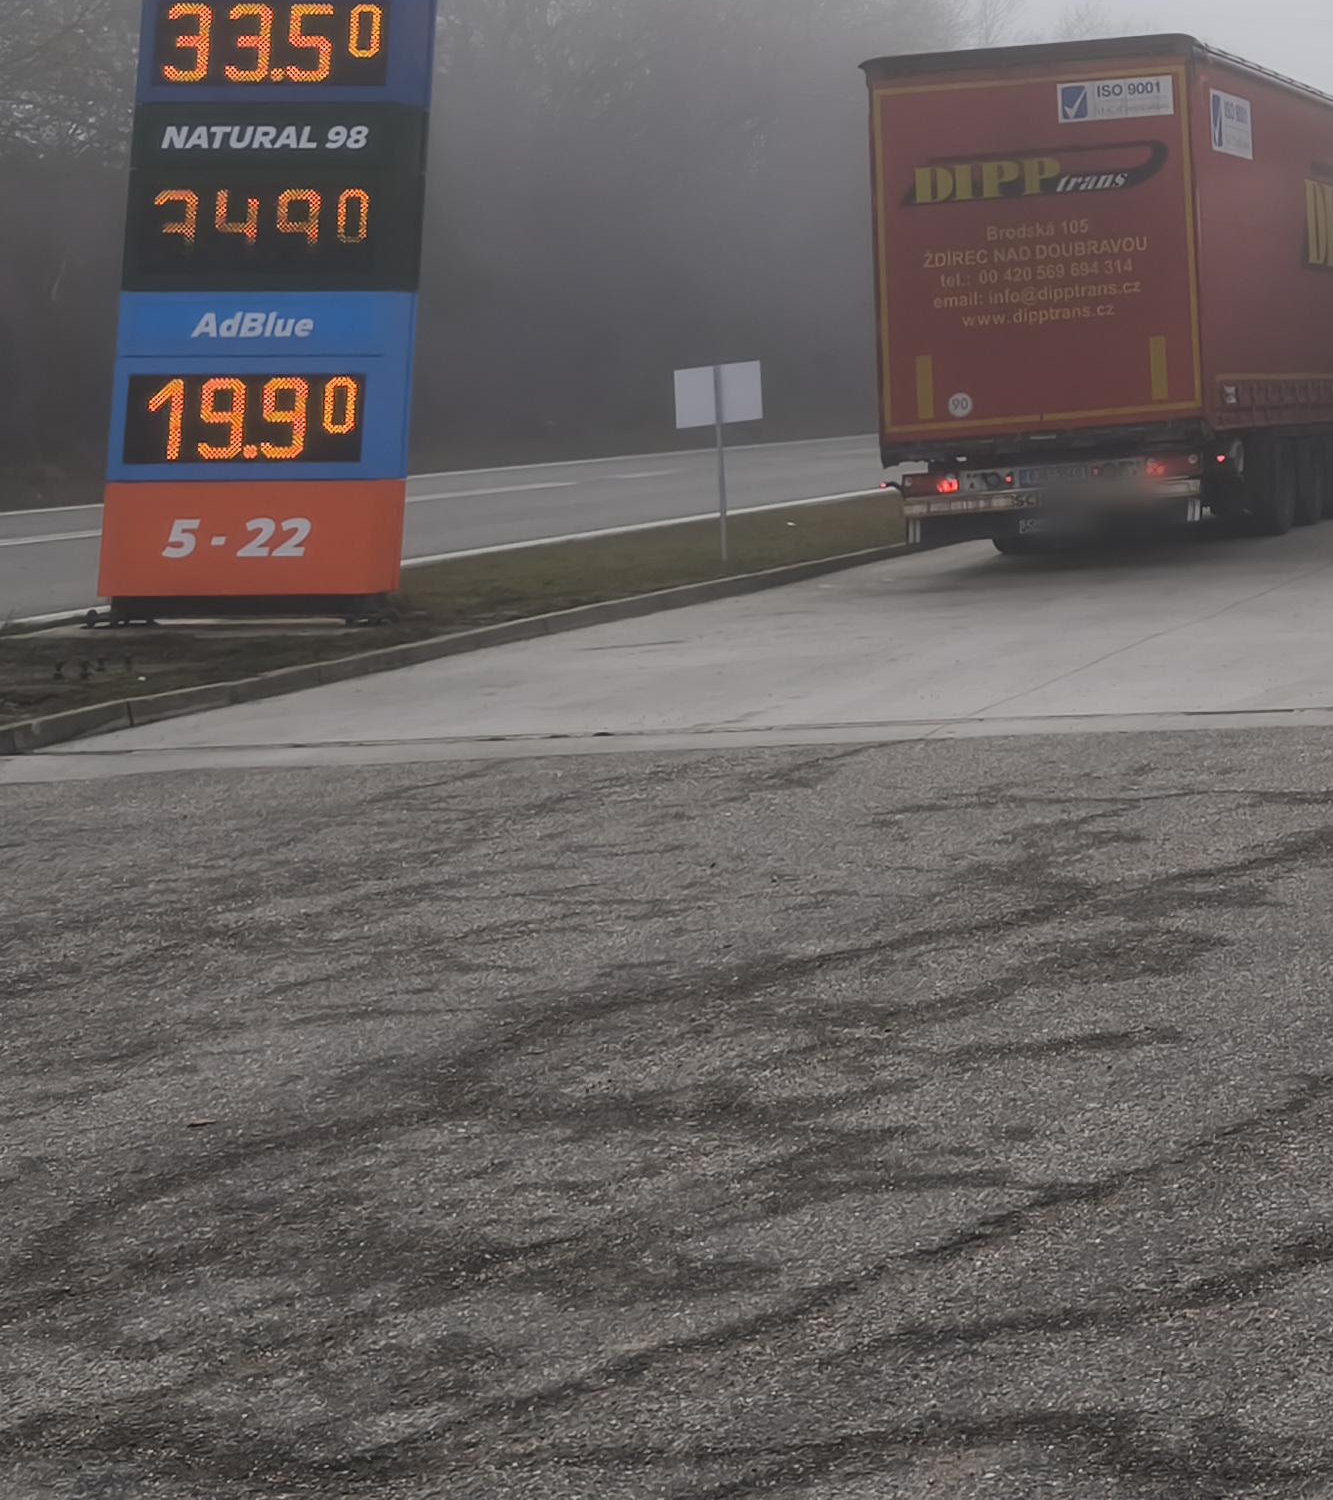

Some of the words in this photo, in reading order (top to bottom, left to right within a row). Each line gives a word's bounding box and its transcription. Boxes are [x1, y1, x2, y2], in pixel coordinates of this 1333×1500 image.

[1096, 84, 1122, 98] ISO
[1127, 81, 1161, 97] 9001
[161, 126, 317, 149] NATURAL
[325, 125, 369, 149] 98
[914, 156, 1062, 204] DIPP
[1055, 171, 1128, 194] trans
[986, 221, 1055, 242] Brodská
[1061, 218, 1089, 235] 105
[993, 245, 1031, 263] NAD
[1035, 235, 1148, 260] DOUBRAVOU
[978, 269, 998, 284] 00
[1003, 265, 1032, 282] 420
[1104, 258, 1133, 274] 314
[191, 312, 314, 338] AdBlue
[952, 396, 969, 410] 90
